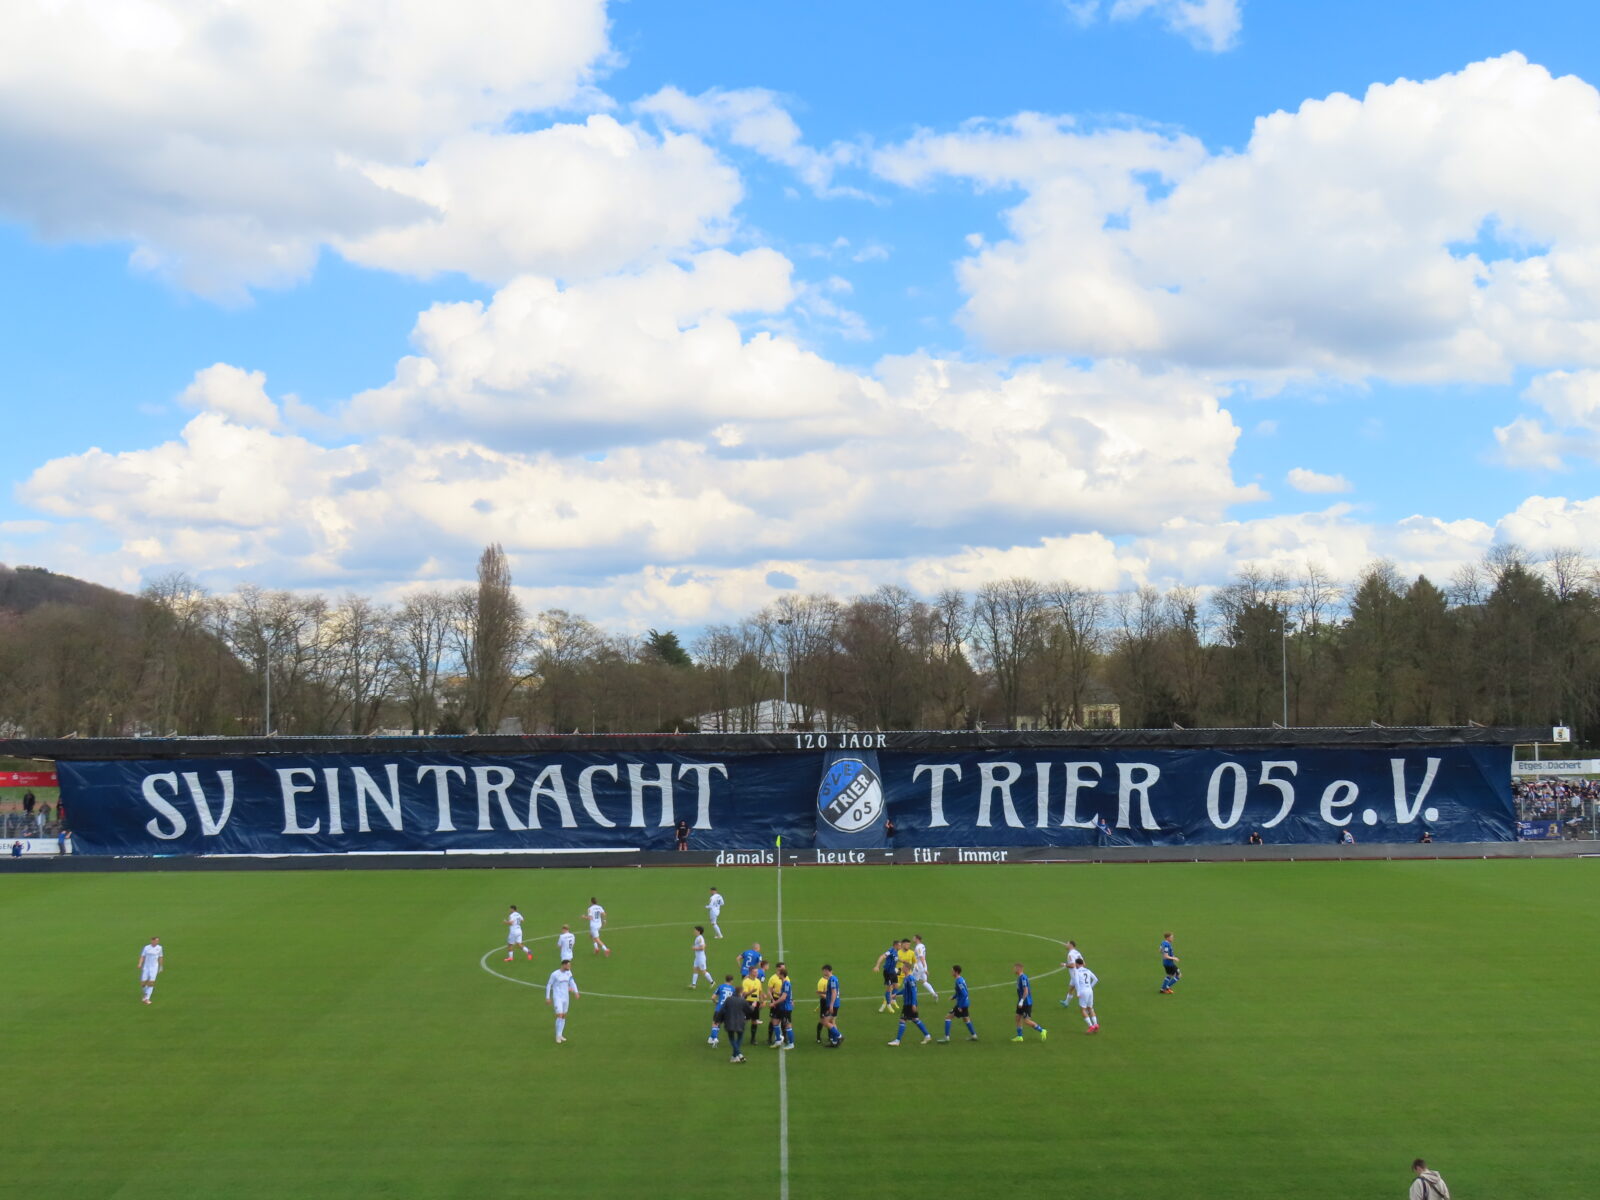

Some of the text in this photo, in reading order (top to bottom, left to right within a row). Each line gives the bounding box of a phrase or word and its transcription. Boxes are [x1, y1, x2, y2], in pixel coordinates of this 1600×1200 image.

[795, 734, 887, 749] 120 JAOR
[142, 770, 234, 839] SV
[276, 763, 728, 835] EINTRACHT
[912, 761, 1160, 830] TRIER
[1207, 760, 1298, 830] 05
[829, 774, 869, 814] TRIER
[853, 802, 872, 822] 05
[716, 850, 774, 864] damals
[817, 849, 866, 864] heute
[913, 848, 941, 863] für
[958, 848, 1008, 862] immer
[745, 956, 752, 968] 2
[1083, 973, 1089, 984] 2
